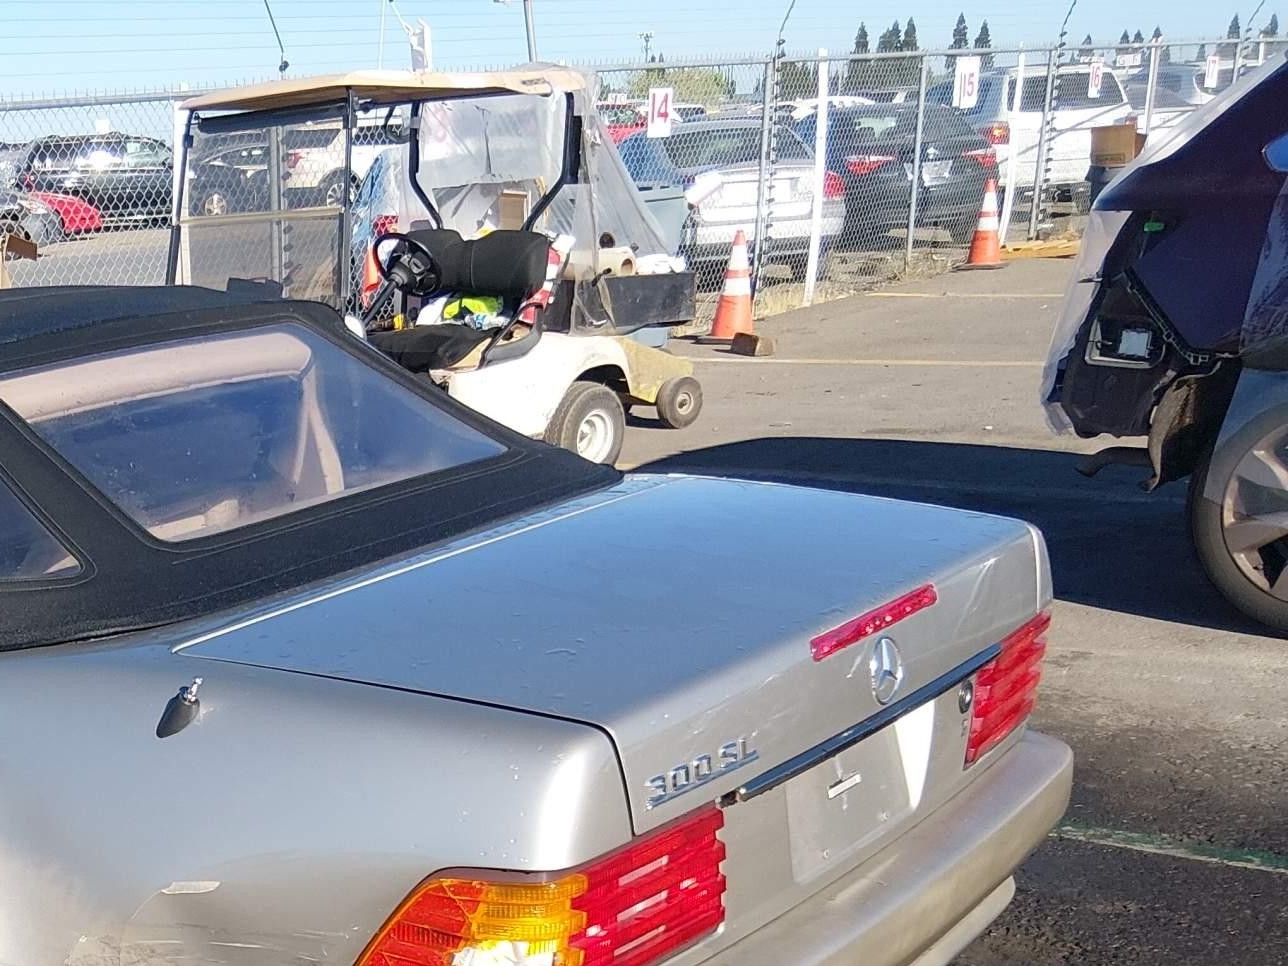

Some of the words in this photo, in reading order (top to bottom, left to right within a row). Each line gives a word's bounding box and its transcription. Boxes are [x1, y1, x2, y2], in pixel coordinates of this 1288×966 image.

[1091, 65, 1100, 88] 16
[651, 92, 669, 124] 14
[644, 754, 713, 803] 300
[717, 738, 760, 769] SL
